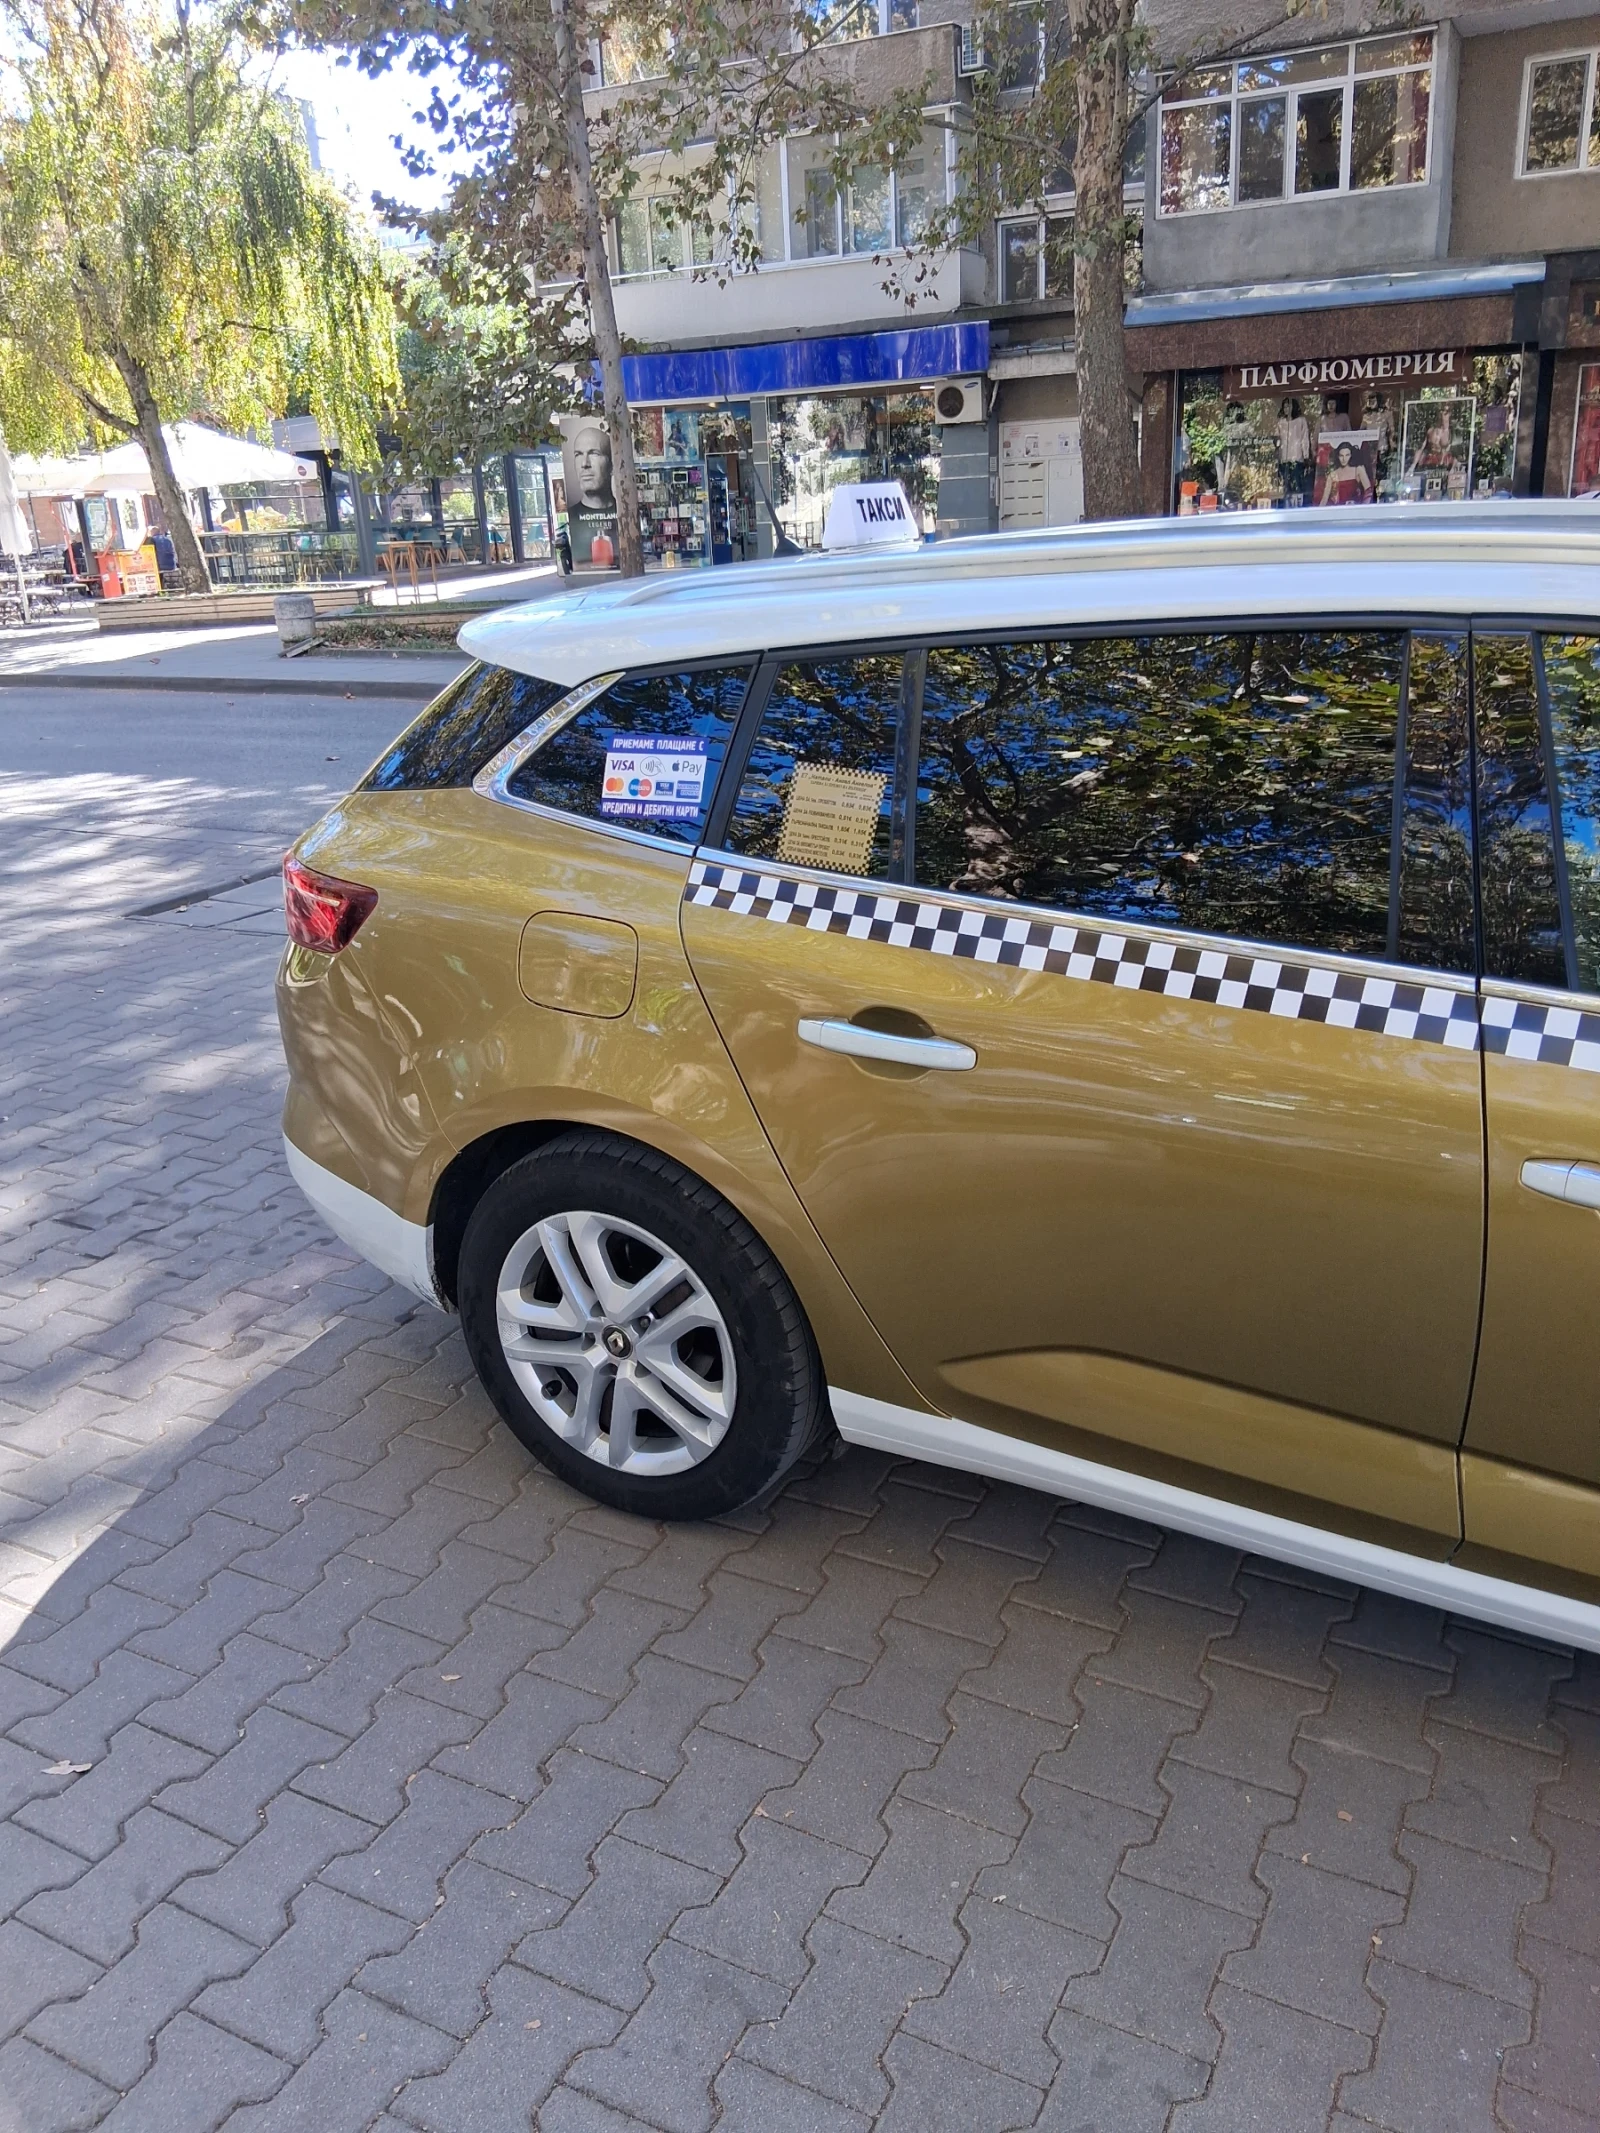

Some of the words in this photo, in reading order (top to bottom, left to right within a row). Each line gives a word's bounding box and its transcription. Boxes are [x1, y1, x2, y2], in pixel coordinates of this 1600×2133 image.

[1239, 351, 1456, 389] ПАРФЮМЕРИЯ
[856, 497, 906, 523] ТАКСИ
[613, 738, 655, 749] ПРИЕМАМЕ
[657, 739, 696, 751] ПЛАЩАНЕ
[610, 760, 635, 771] VISA
[681, 760, 702, 776] Pay
[602, 802, 636, 814] КРЕДИТНИ
[637, 804, 642, 814] И
[643, 804, 675, 816] ДЕБИТНИ
[675, 806, 698, 817] КАРТИ
